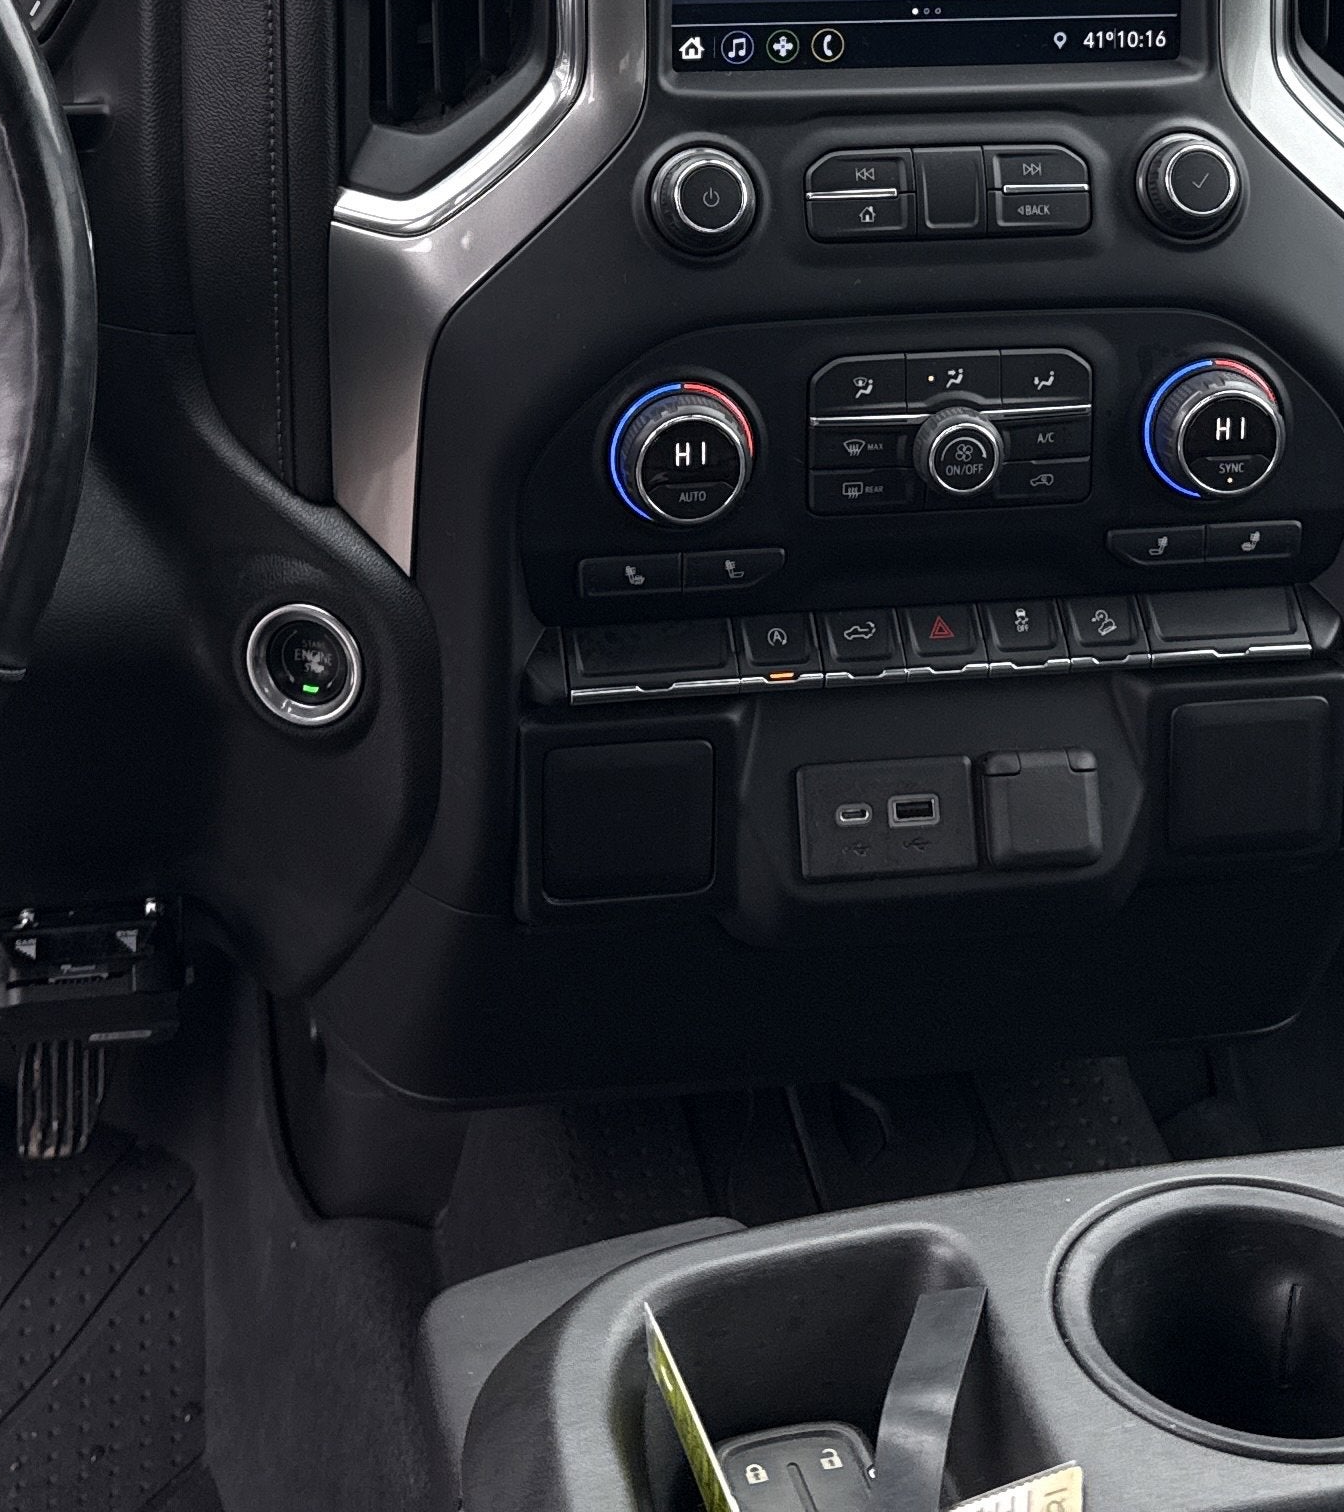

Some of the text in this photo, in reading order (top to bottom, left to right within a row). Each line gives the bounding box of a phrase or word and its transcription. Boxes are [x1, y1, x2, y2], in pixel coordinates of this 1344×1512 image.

[1117, 30, 1167, 48] 10:16
[1025, 204, 1051, 216] BACK
[1037, 432, 1055, 444] A/C
[867, 442, 884, 451] MAX
[945, 463, 985, 477] ON/OFF
[1218, 462, 1245, 475] SYNC
[864, 484, 884, 494] REAR
[678, 490, 707, 503] AUTO
